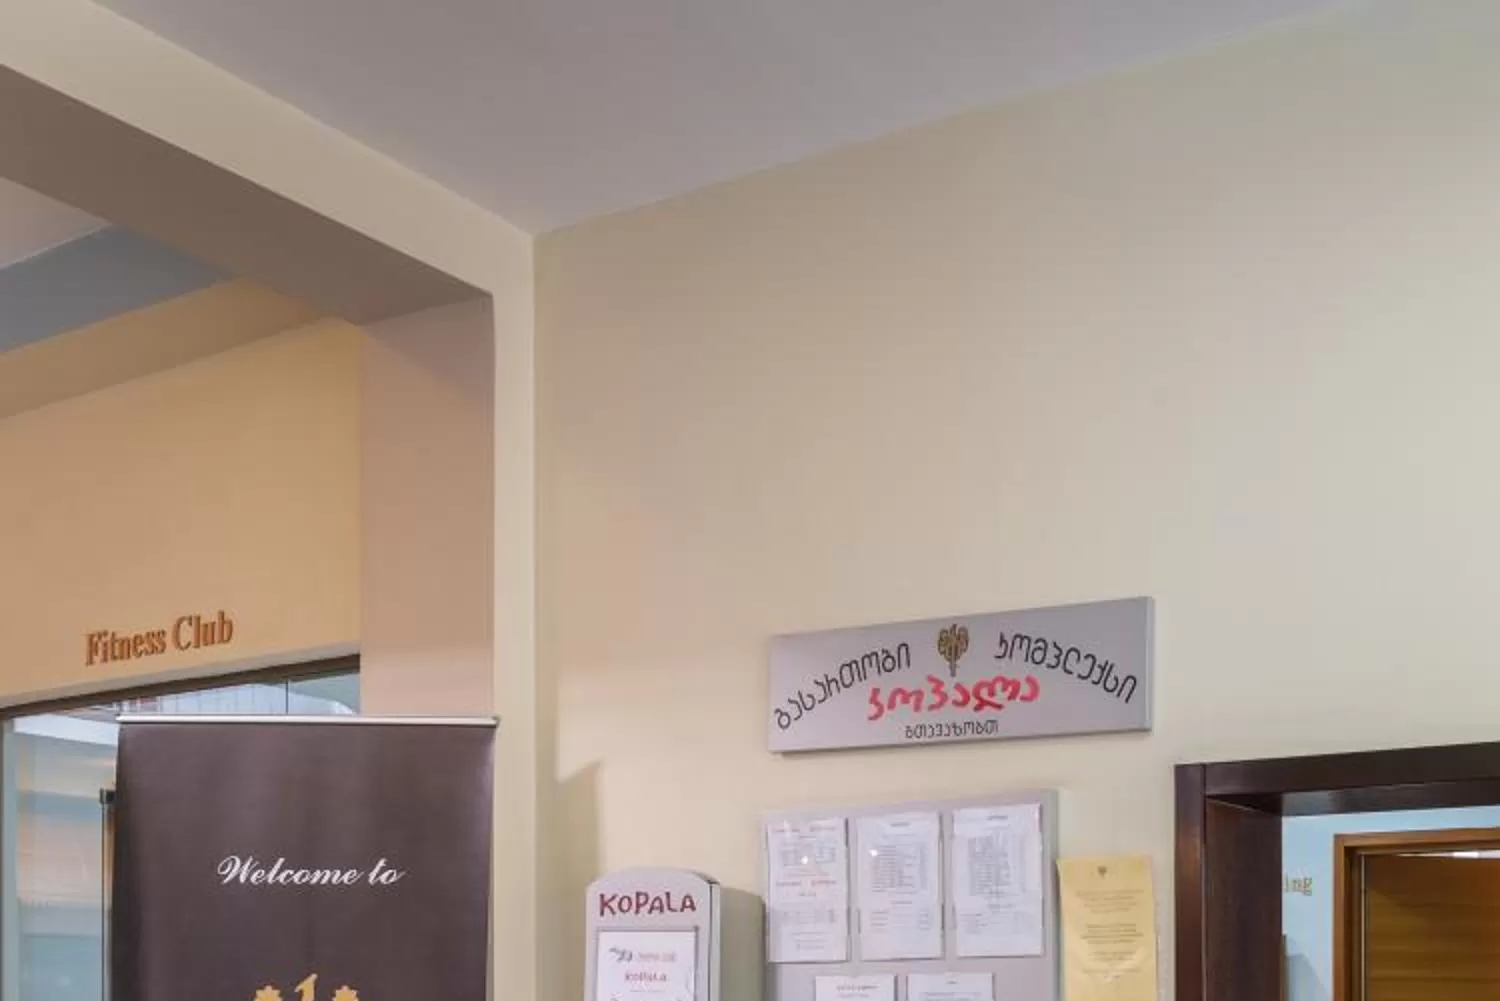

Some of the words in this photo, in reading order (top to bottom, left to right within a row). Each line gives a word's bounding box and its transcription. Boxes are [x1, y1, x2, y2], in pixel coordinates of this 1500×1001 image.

[85, 629, 167, 667] Fitness
[172, 610, 234, 651] Club
[774, 642, 910, 730] გასართობი
[994, 631, 1138, 704] კომპლექსი
[217, 855, 365, 886] Welcome
[367, 857, 407, 886] to
[599, 891, 696, 917] KOPALA
